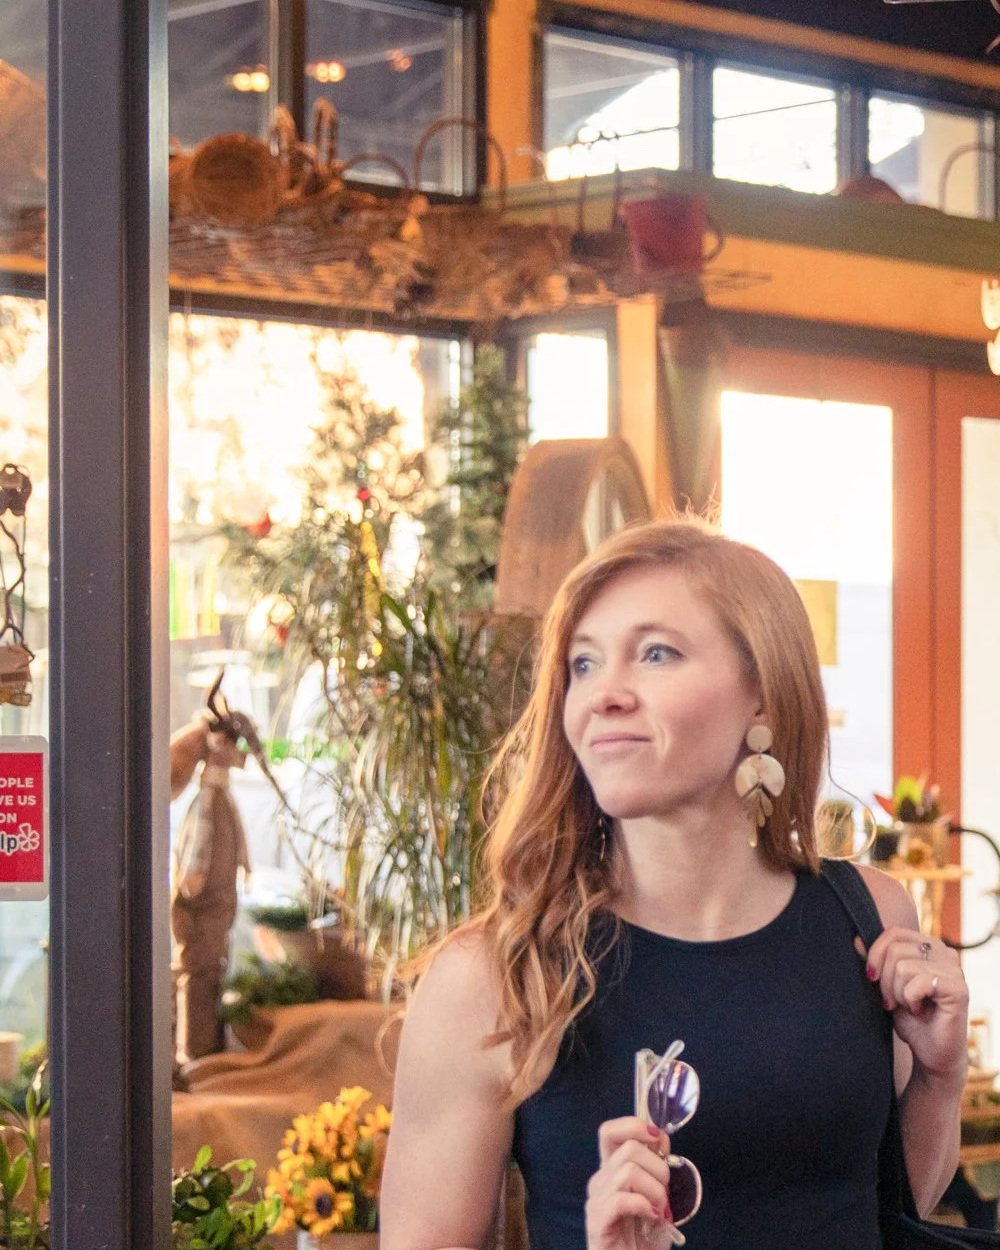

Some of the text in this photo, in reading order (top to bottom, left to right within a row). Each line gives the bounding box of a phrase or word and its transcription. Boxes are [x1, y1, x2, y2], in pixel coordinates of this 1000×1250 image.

[0, 778, 34, 788] OPLE
[17, 795, 37, 806] US
[0, 813, 17, 823] ON
